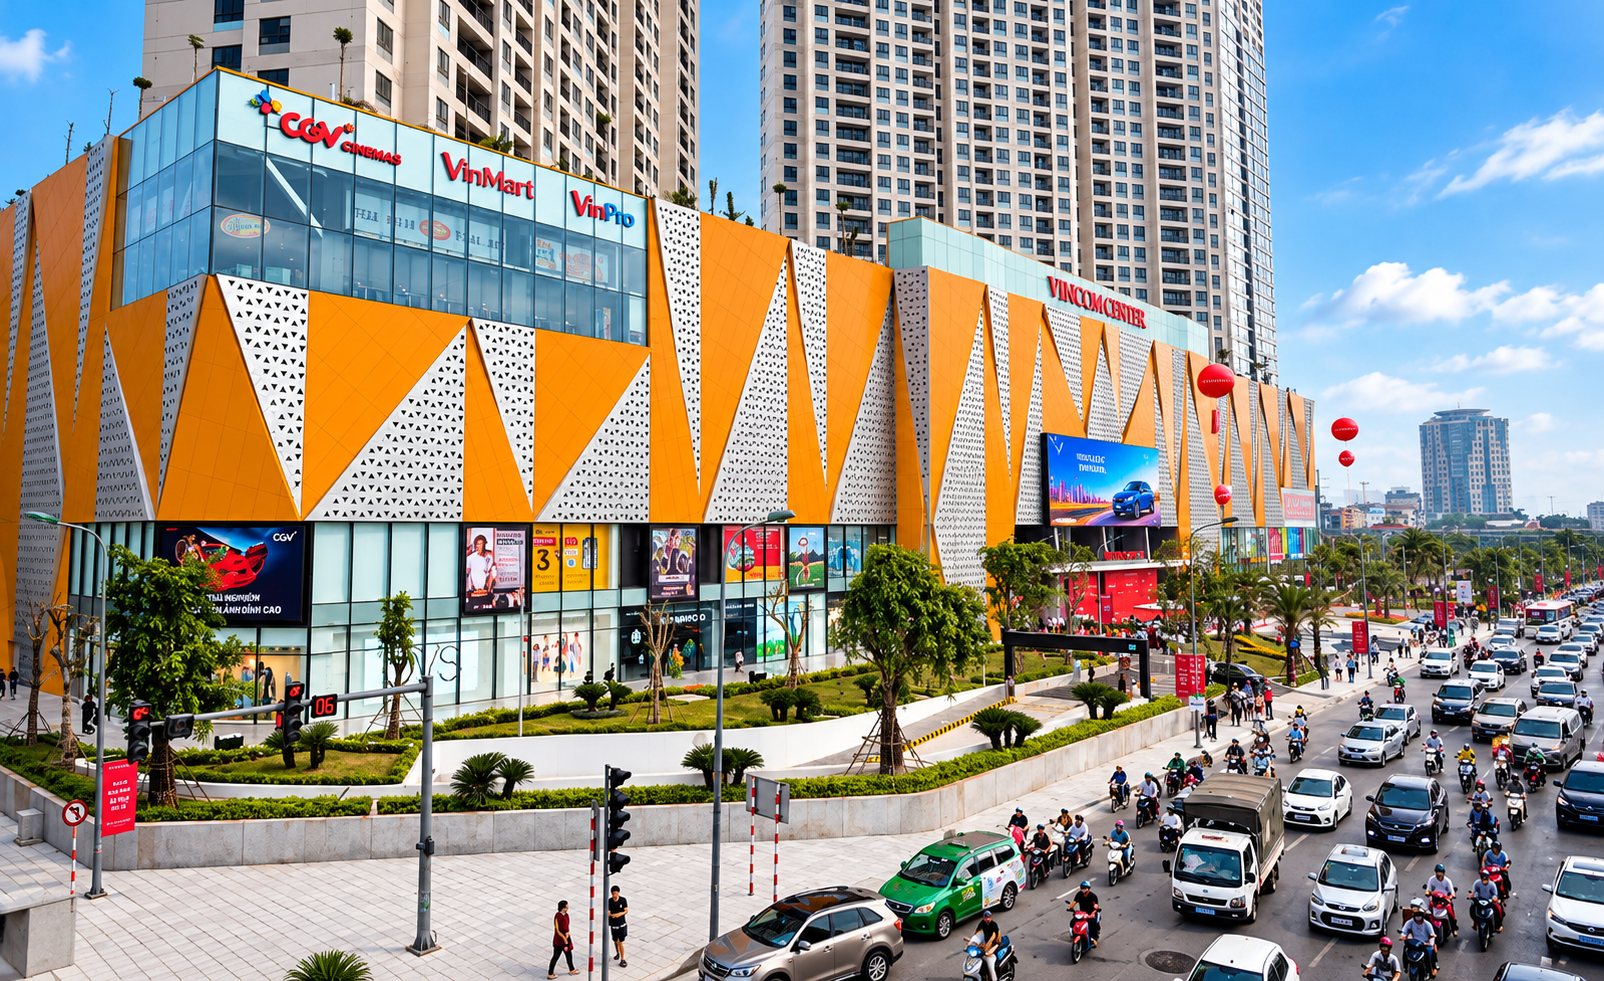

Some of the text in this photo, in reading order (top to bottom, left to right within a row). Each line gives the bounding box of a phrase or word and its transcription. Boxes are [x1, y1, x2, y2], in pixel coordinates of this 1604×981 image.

[279, 112, 345, 149] CGV
[342, 141, 402, 166] CINEMAS
[441, 151, 535, 199] VinMart
[570, 190, 635, 228] VinPro
[1047, 275, 1147, 329] VINCOM CENTER
[272, 531, 295, 542] CGV
[537, 548, 550, 571] 3
[262, 605, 282, 614] CAO
[315, 697, 334, 716] 06
